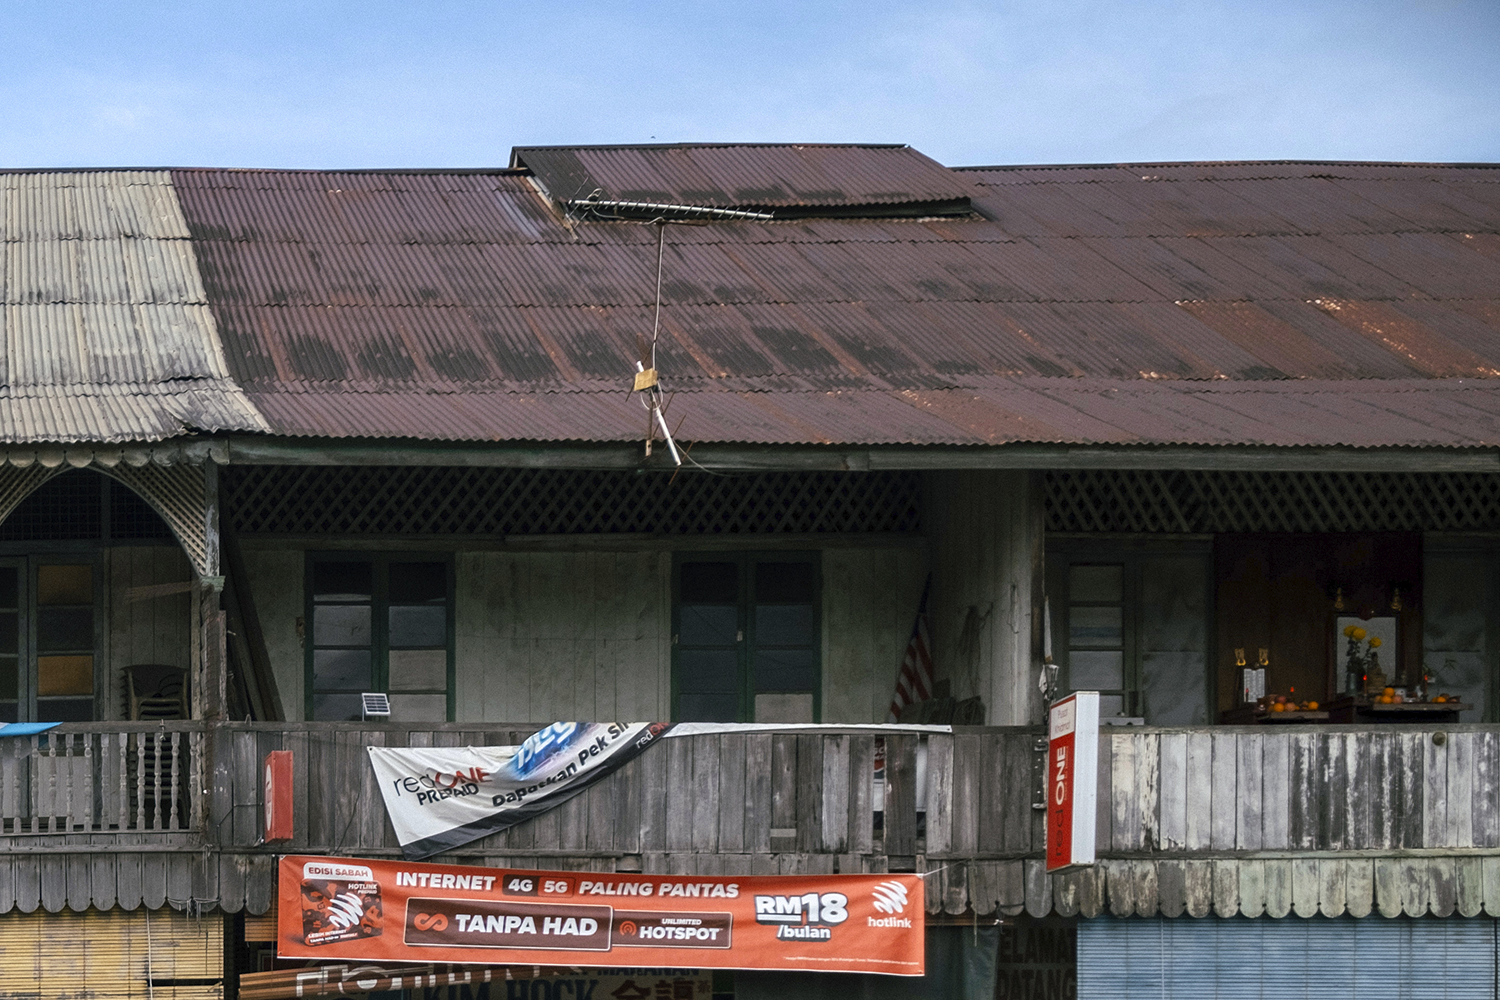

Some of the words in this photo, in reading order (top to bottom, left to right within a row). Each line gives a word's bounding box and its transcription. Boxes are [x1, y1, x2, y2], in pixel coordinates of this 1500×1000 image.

[417, 783, 479, 805] PREPAID
[308, 867, 333, 876] EDISI
[335, 868, 368, 877] SABAH
[396, 872, 496, 891] INTERNET
[508, 878, 533, 892] 4G
[543, 880, 568, 893] 5G
[579, 881, 653, 896] PALING
[658, 882, 740, 898] PANTAS
[755, 892, 849, 924] RM18
[455, 914, 537, 935] TANPA
[543, 917, 598, 936] HAD
[867, 916, 912, 928] hotlink
[639, 926, 720, 941] HOTSPOT
[776, 925, 831, 939] /bulan
